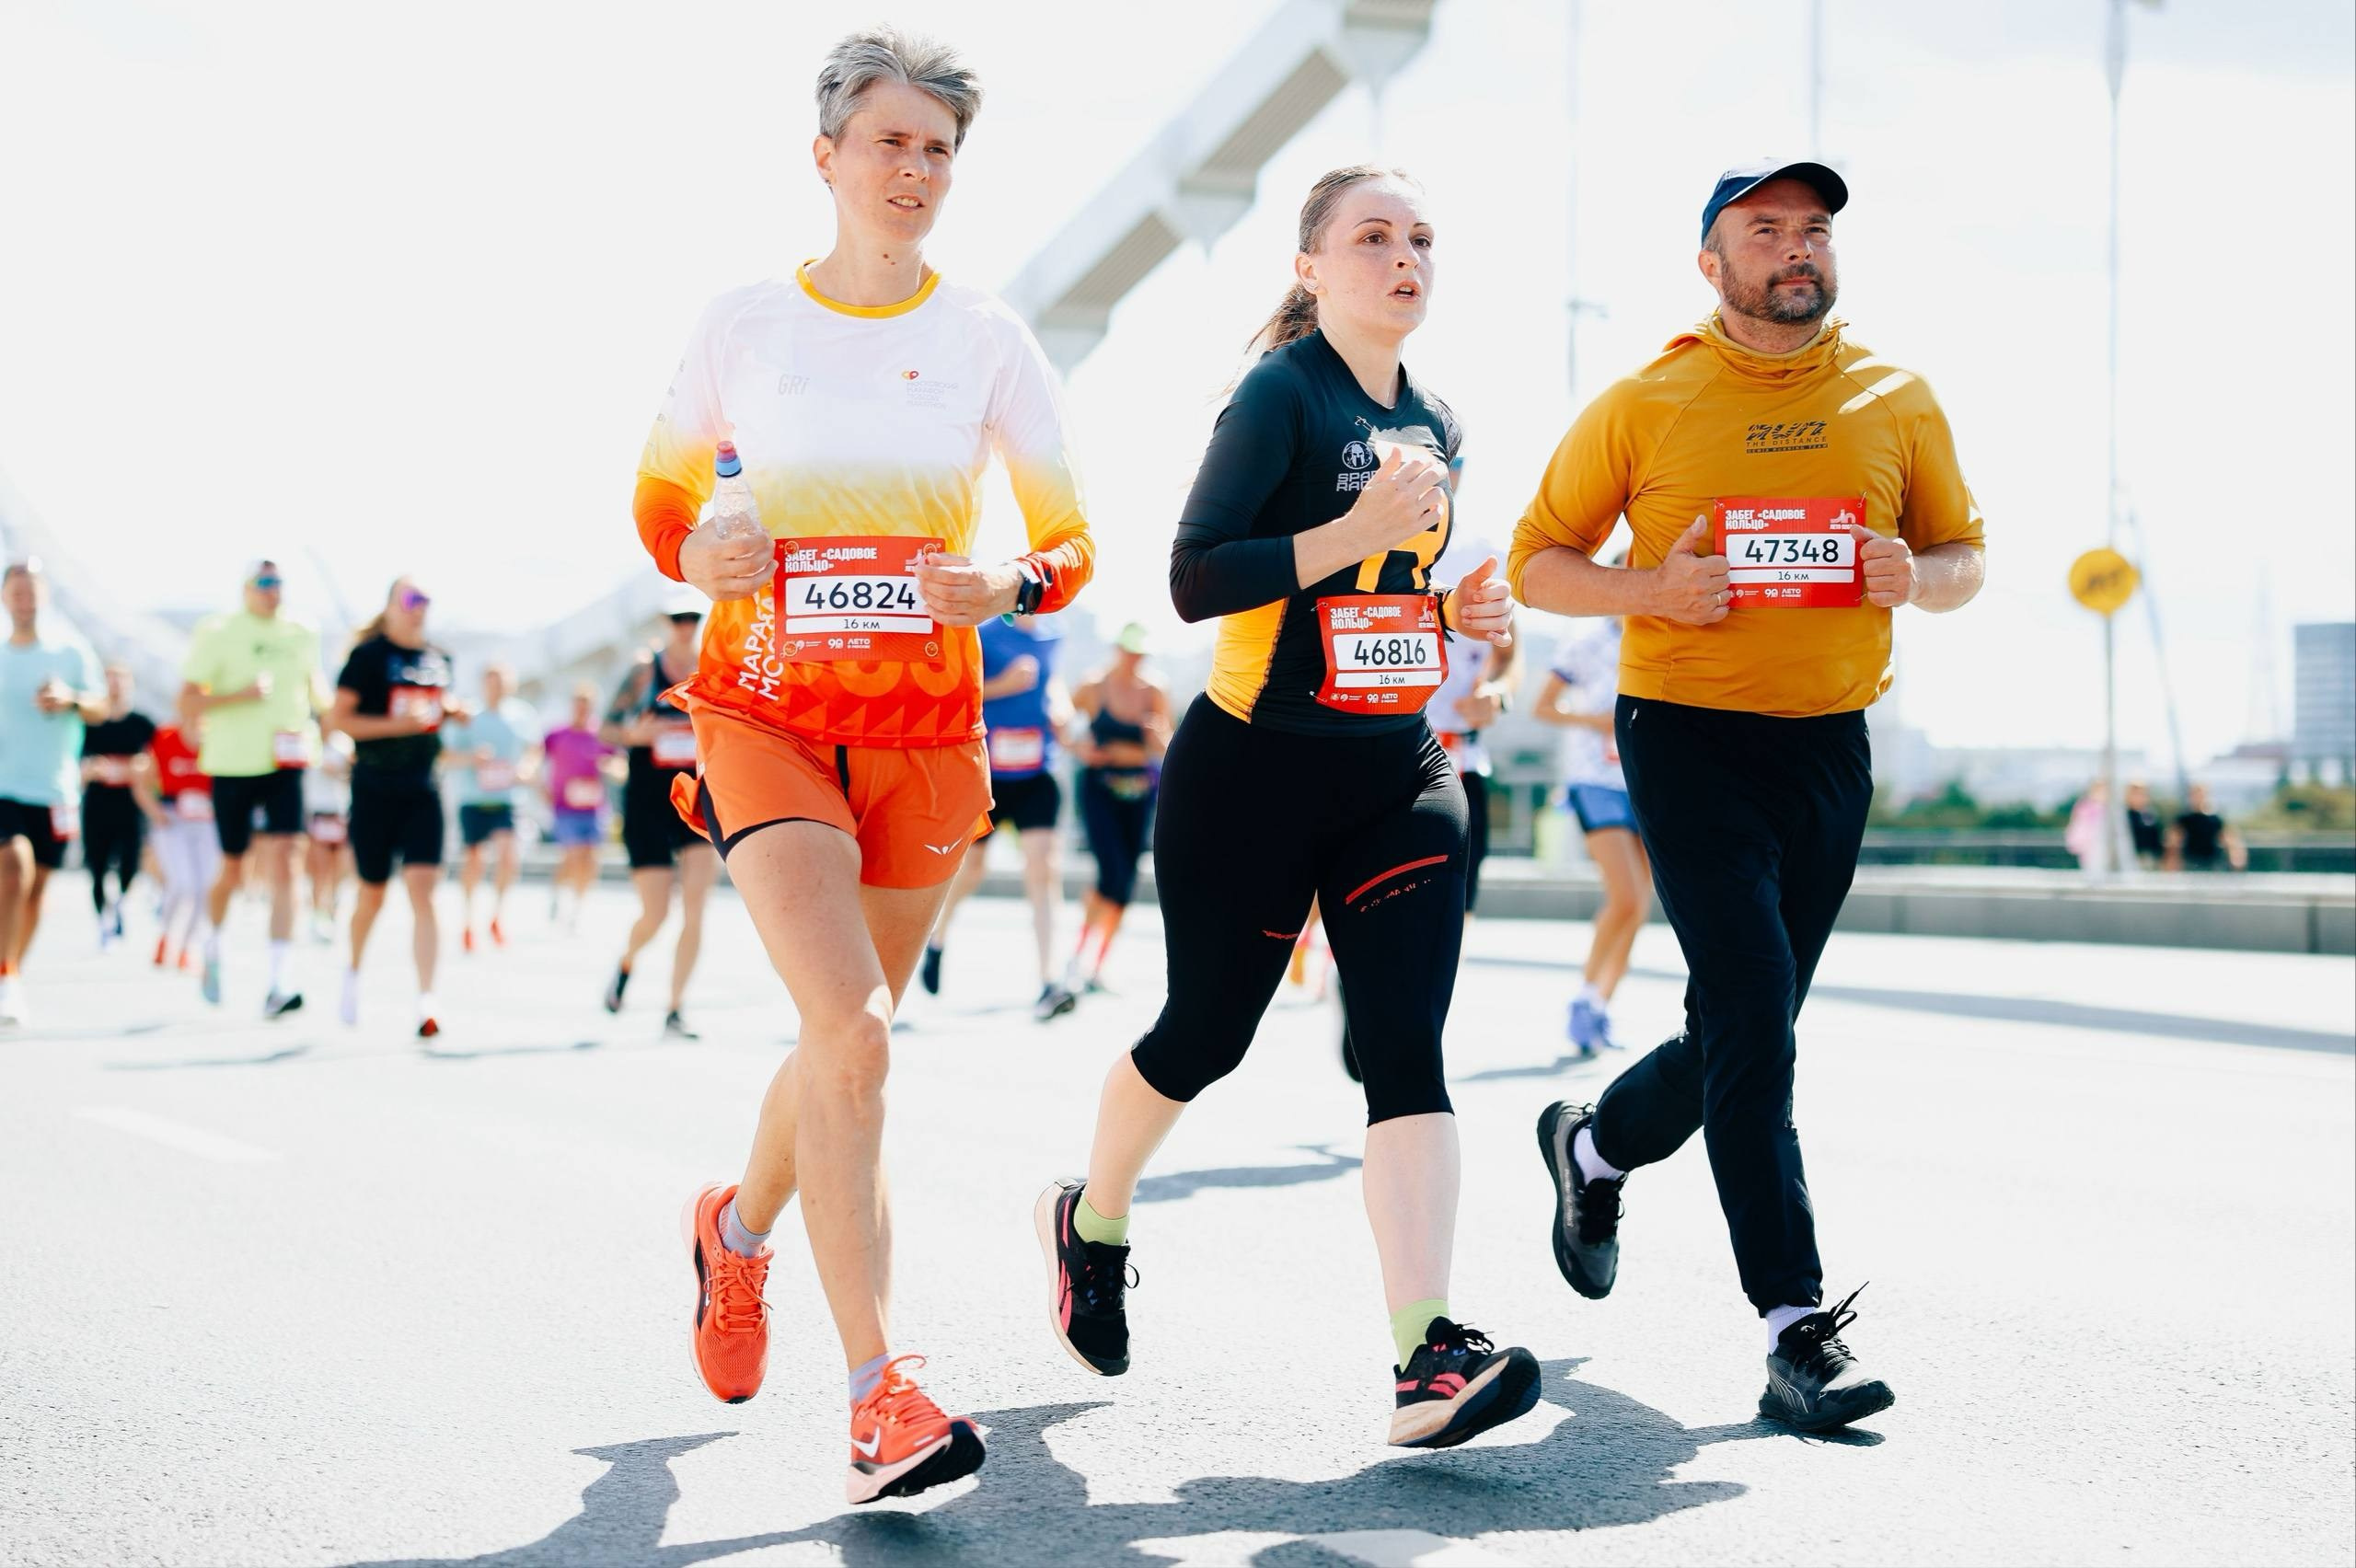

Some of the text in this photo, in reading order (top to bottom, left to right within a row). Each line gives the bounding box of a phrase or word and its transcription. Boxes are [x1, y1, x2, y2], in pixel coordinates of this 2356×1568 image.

[1773, 436, 1827, 445] DISTANCE
[1726, 509, 1807, 521] ЗАБЕГ «САДОВОЕ
[1726, 519, 1770, 531] КОЛЬЦО»
[785, 548, 878, 562] ЗАБЕГ «САДОВОЕ
[1745, 539, 1839, 563] 47348
[785, 559, 835, 573] КОЛЬЦО»
[1778, 571, 1791, 581] 16
[805, 582, 916, 610] 46824
[1330, 606, 1402, 619] ЗАБЕГ «САДОВОЕ
[844, 618, 860, 629] 16
[1331, 617, 1374, 630] КОЛЬЦО»
[1355, 639, 1426, 665] 46816
[1380, 674, 1391, 685] 16
